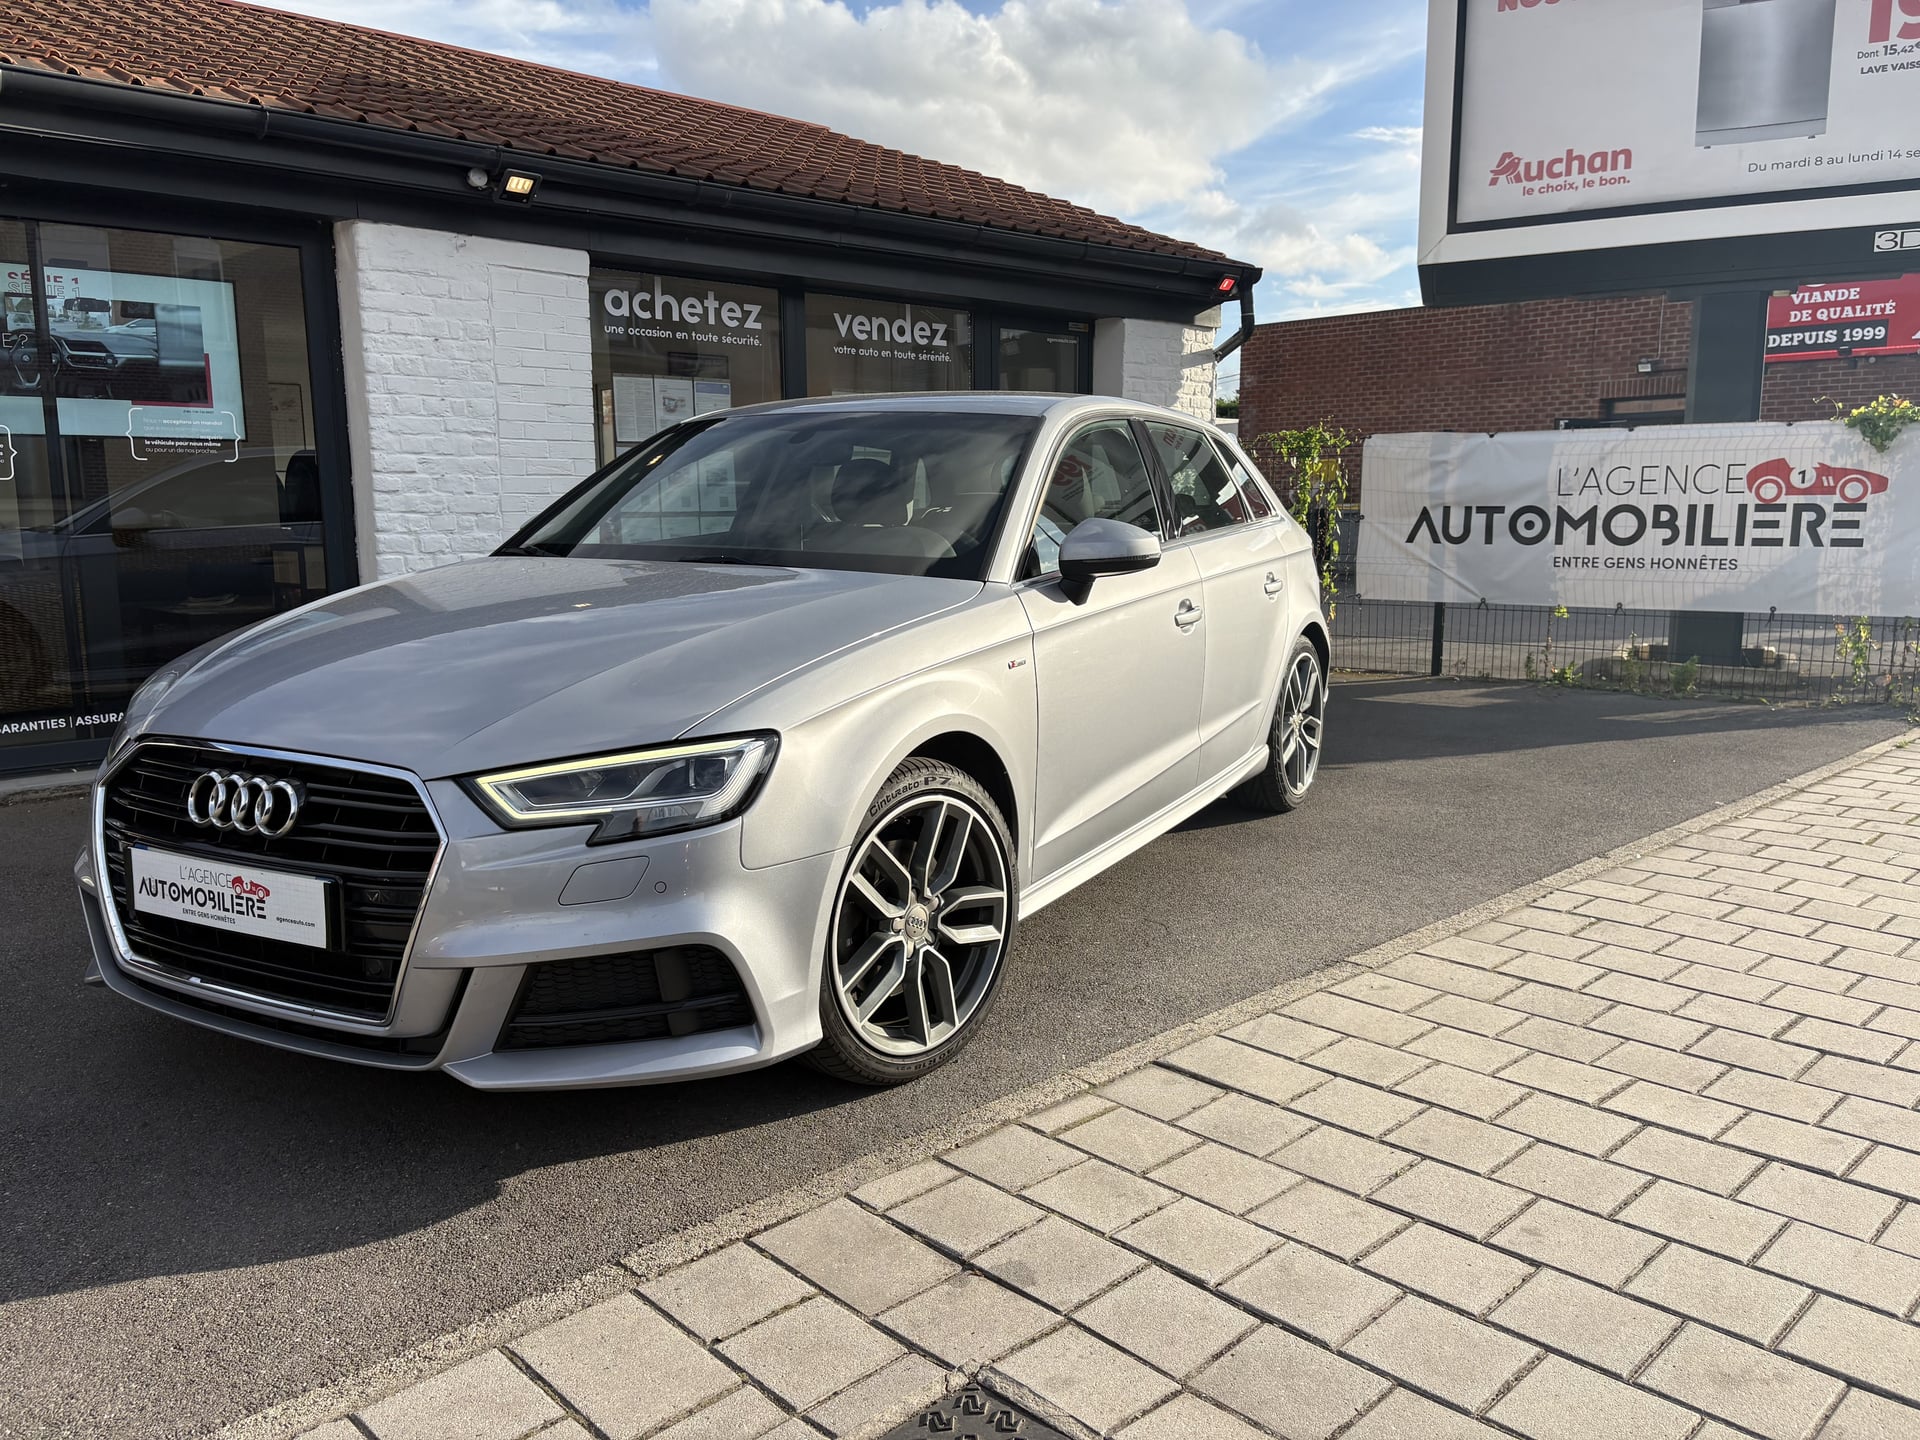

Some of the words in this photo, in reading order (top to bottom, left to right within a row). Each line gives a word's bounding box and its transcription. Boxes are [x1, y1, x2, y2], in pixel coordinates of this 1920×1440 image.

[1857, 50, 1880, 59] Dont
[1860, 64, 1888, 75] LAVE
[1488, 148, 1632, 187] Auchan
[1748, 162, 1766, 173] Du
[1771, 156, 1811, 171] mardi
[1814, 156, 1823, 166] 8
[1827, 155, 1844, 165] au
[1848, 150, 1883, 163] lundi
[1887, 149, 1902, 160] 14
[1522, 186, 1535, 196] le
[1538, 180, 1579, 194] choix,
[1582, 178, 1595, 189] le
[1599, 175, 1631, 187] bon.
[604, 276, 762, 330] achetez
[1790, 287, 1861, 305] VIANDE
[1789, 310, 1812, 323] DE
[1816, 299, 1896, 321] QUALITÉ
[604, 325, 625, 335] une
[628, 326, 673, 339] occasion
[676, 330, 689, 340] en
[691, 331, 719, 343] toute
[722, 333, 763, 347] sécurité.
[833, 303, 948, 347] vendez
[1767, 329, 1838, 348] DEPUIS
[1842, 326, 1886, 342] 1999
[833, 345, 857, 355] votre
[858, 348, 879, 357] auto
[881, 350, 892, 358] en
[894, 349, 916, 360] toute
[918, 350, 952, 363] sérénité.
[1553, 556, 1600, 569] ENTRE
[1603, 557, 1646, 569] GENS
[1650, 554, 1738, 571] HONNÊTES
[0, 718, 66, 735] ARANTIES
[869, 780, 920, 818] Cinturato
[923, 776, 953, 786] P7
